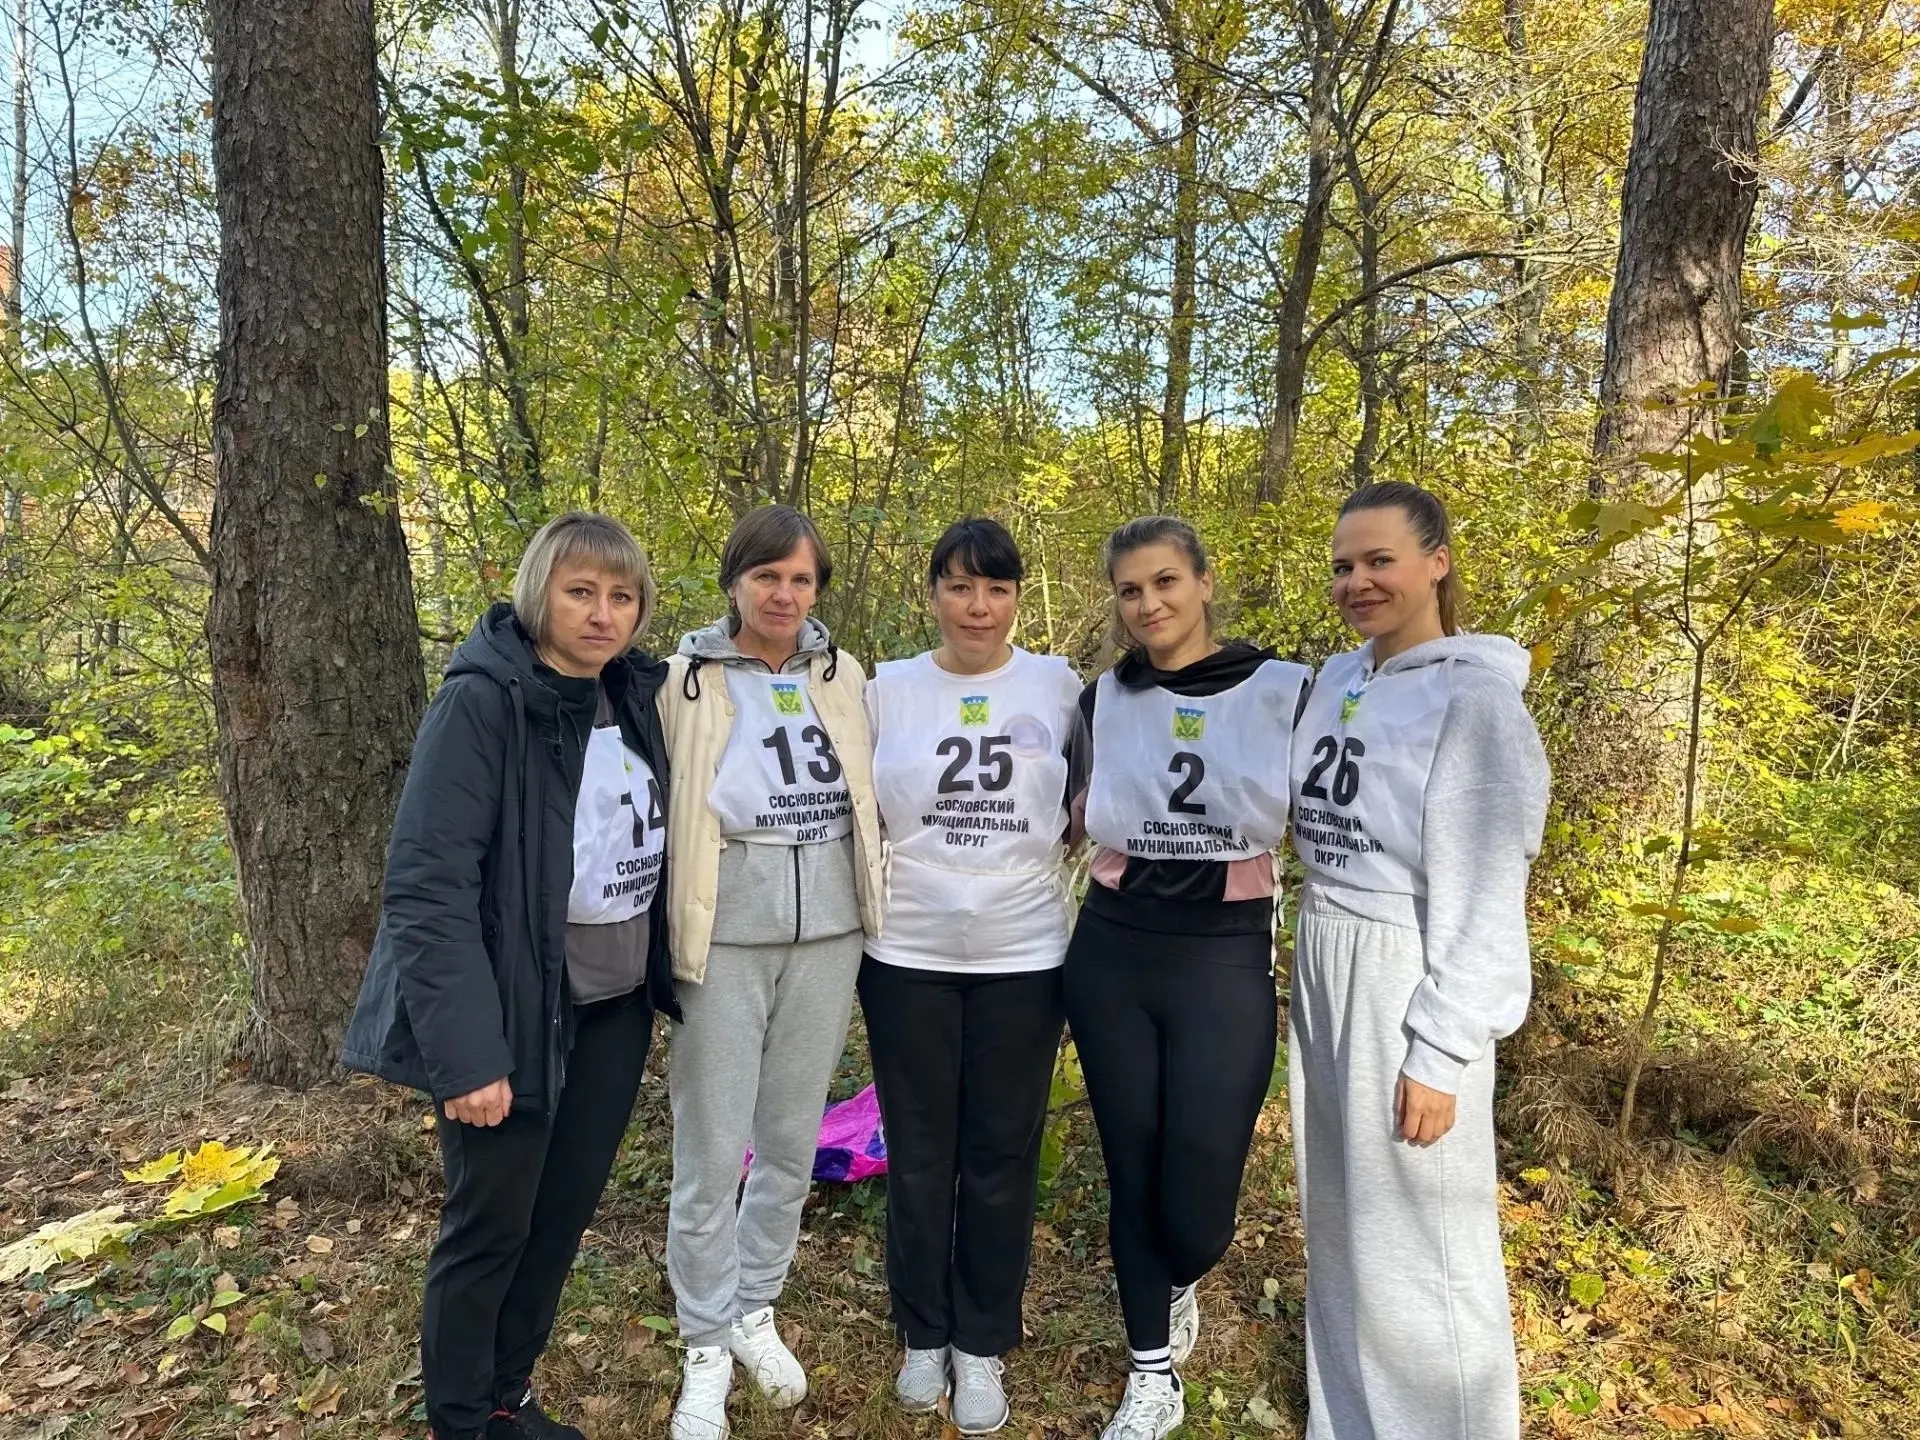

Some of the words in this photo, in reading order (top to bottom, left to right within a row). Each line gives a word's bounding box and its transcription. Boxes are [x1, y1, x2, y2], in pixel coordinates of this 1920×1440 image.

[761, 724, 841, 786] 13
[935, 735, 1013, 795] 25
[1300, 735, 1366, 807] 26
[1167, 751, 1207, 816] 2
[768, 789, 850, 809] СОСНОВСКИЙ
[935, 798, 1015, 814] СОСНОВСКИЙ
[620, 778, 665, 849] 14
[921, 814, 1030, 834] МУНИЦИПАЛЬНЫЙ
[1298, 806, 1363, 833] СОСНОВСКИЙ
[796, 825, 829, 842] ОКРУГ
[945, 831, 989, 848] ОКРУГ
[1143, 820, 1234, 840] СОСНОВСКИЙ
[1314, 848, 1349, 869] ОКРУГ
